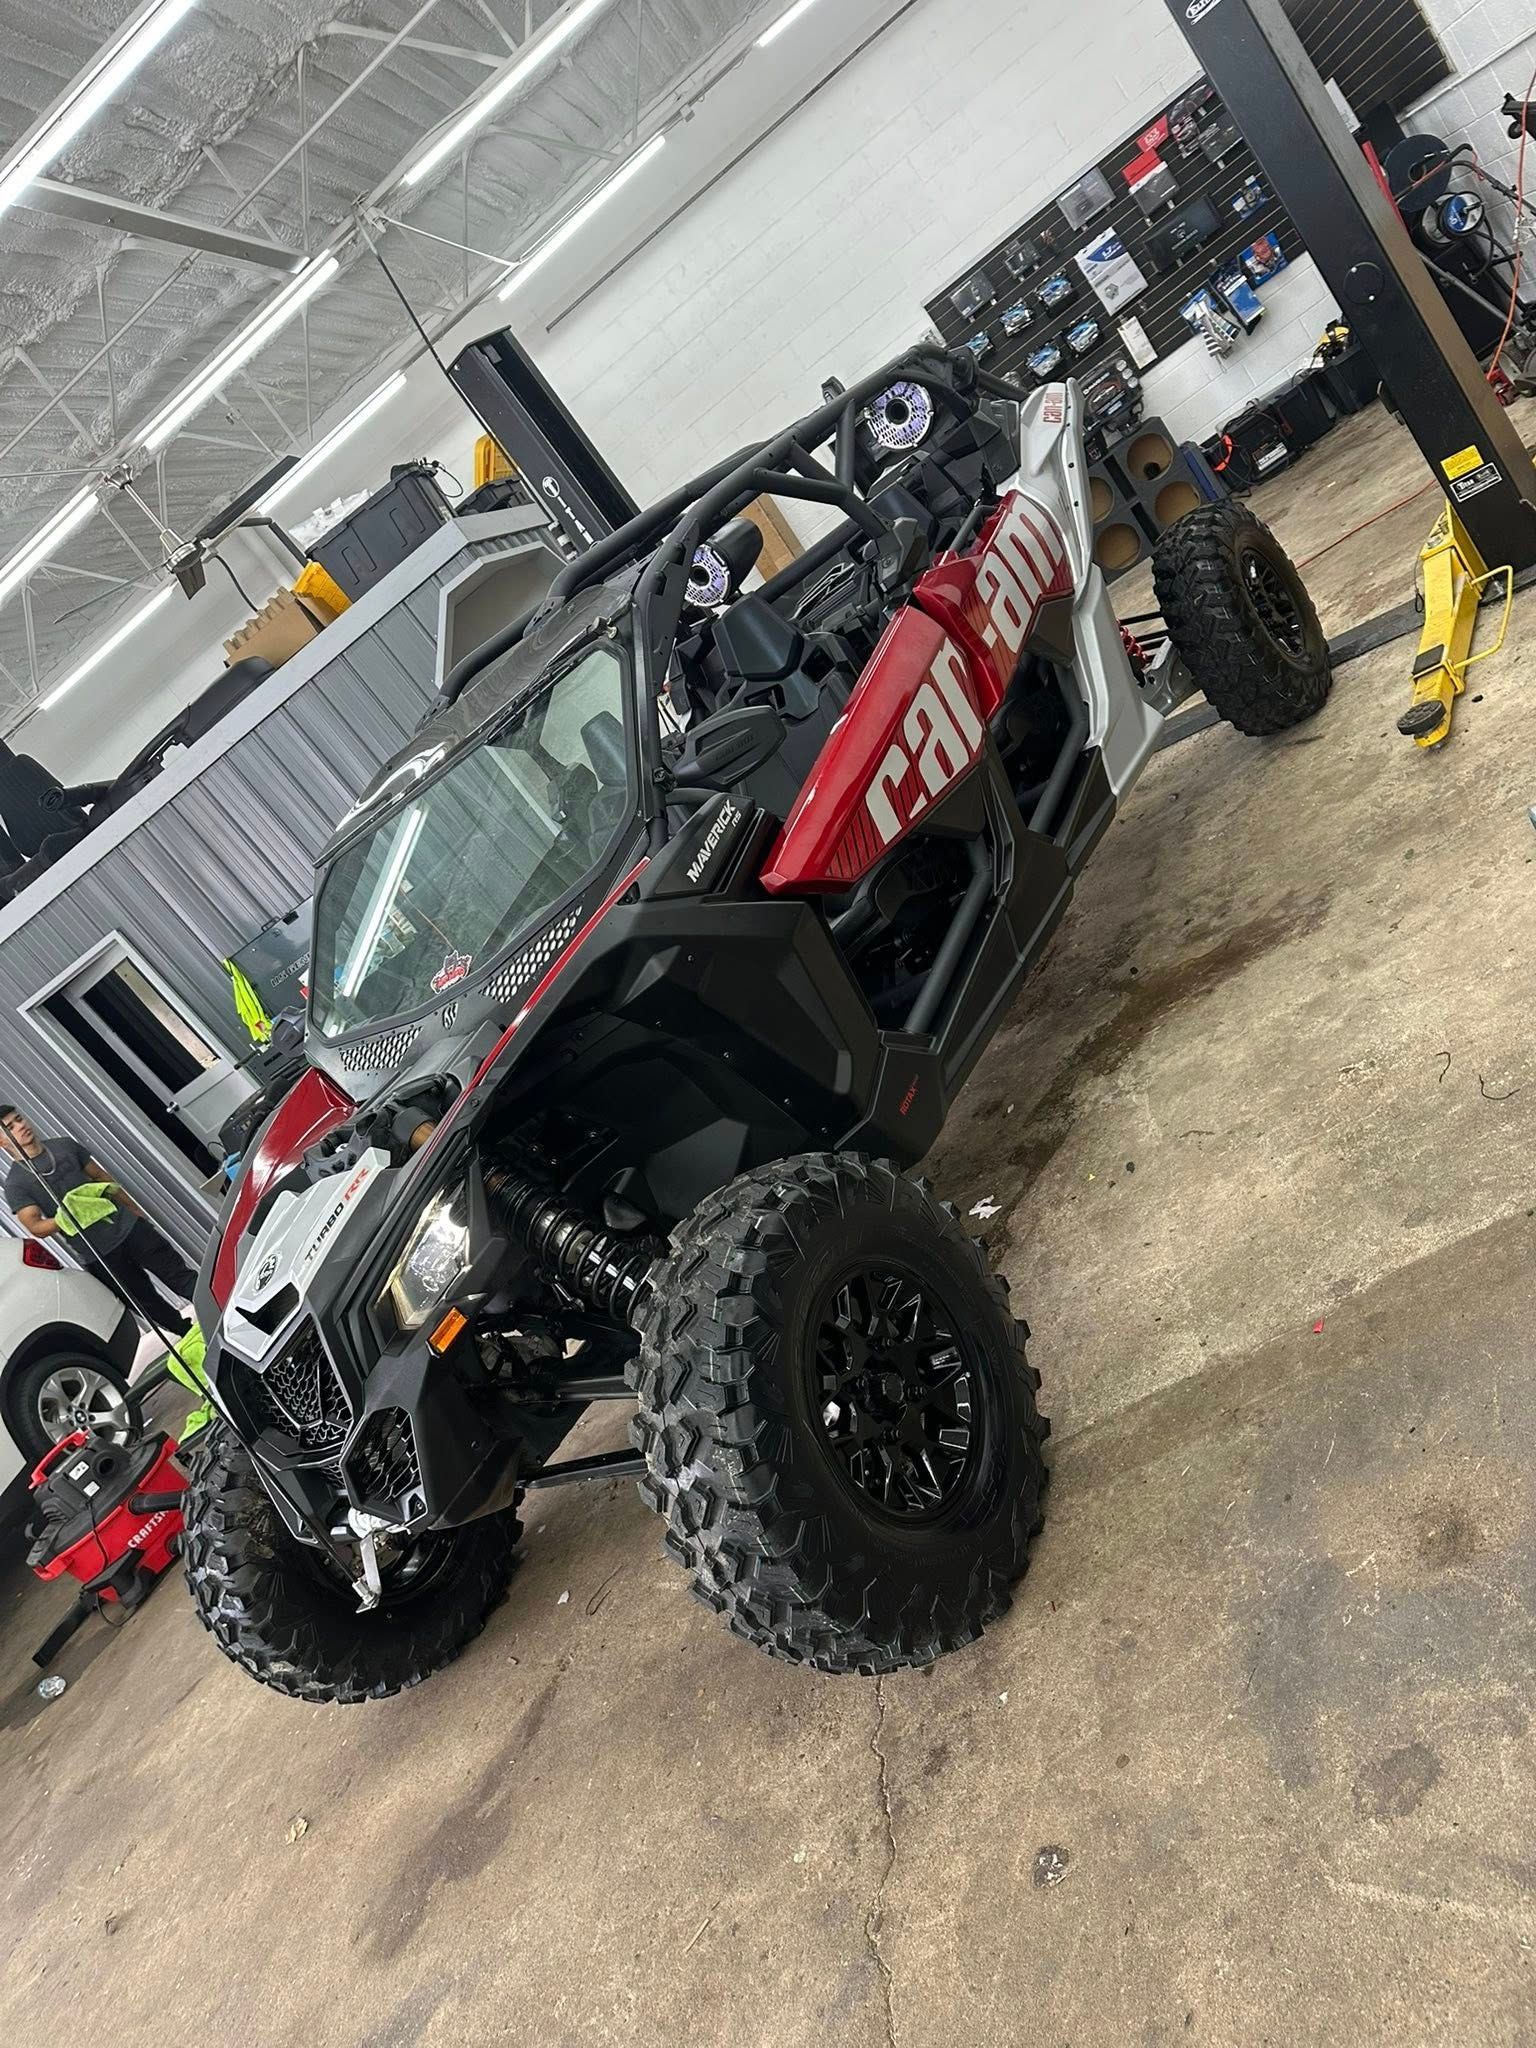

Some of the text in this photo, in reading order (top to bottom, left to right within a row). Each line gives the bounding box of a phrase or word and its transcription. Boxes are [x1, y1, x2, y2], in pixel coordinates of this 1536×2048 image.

[1043, 392, 1063, 423] can-am
[731, 810, 742, 828] RS
[686, 799, 736, 883] MAVERICK
[899, 1086, 917, 1116] ROTAX
[304, 1168, 369, 1261] TURBO RR
